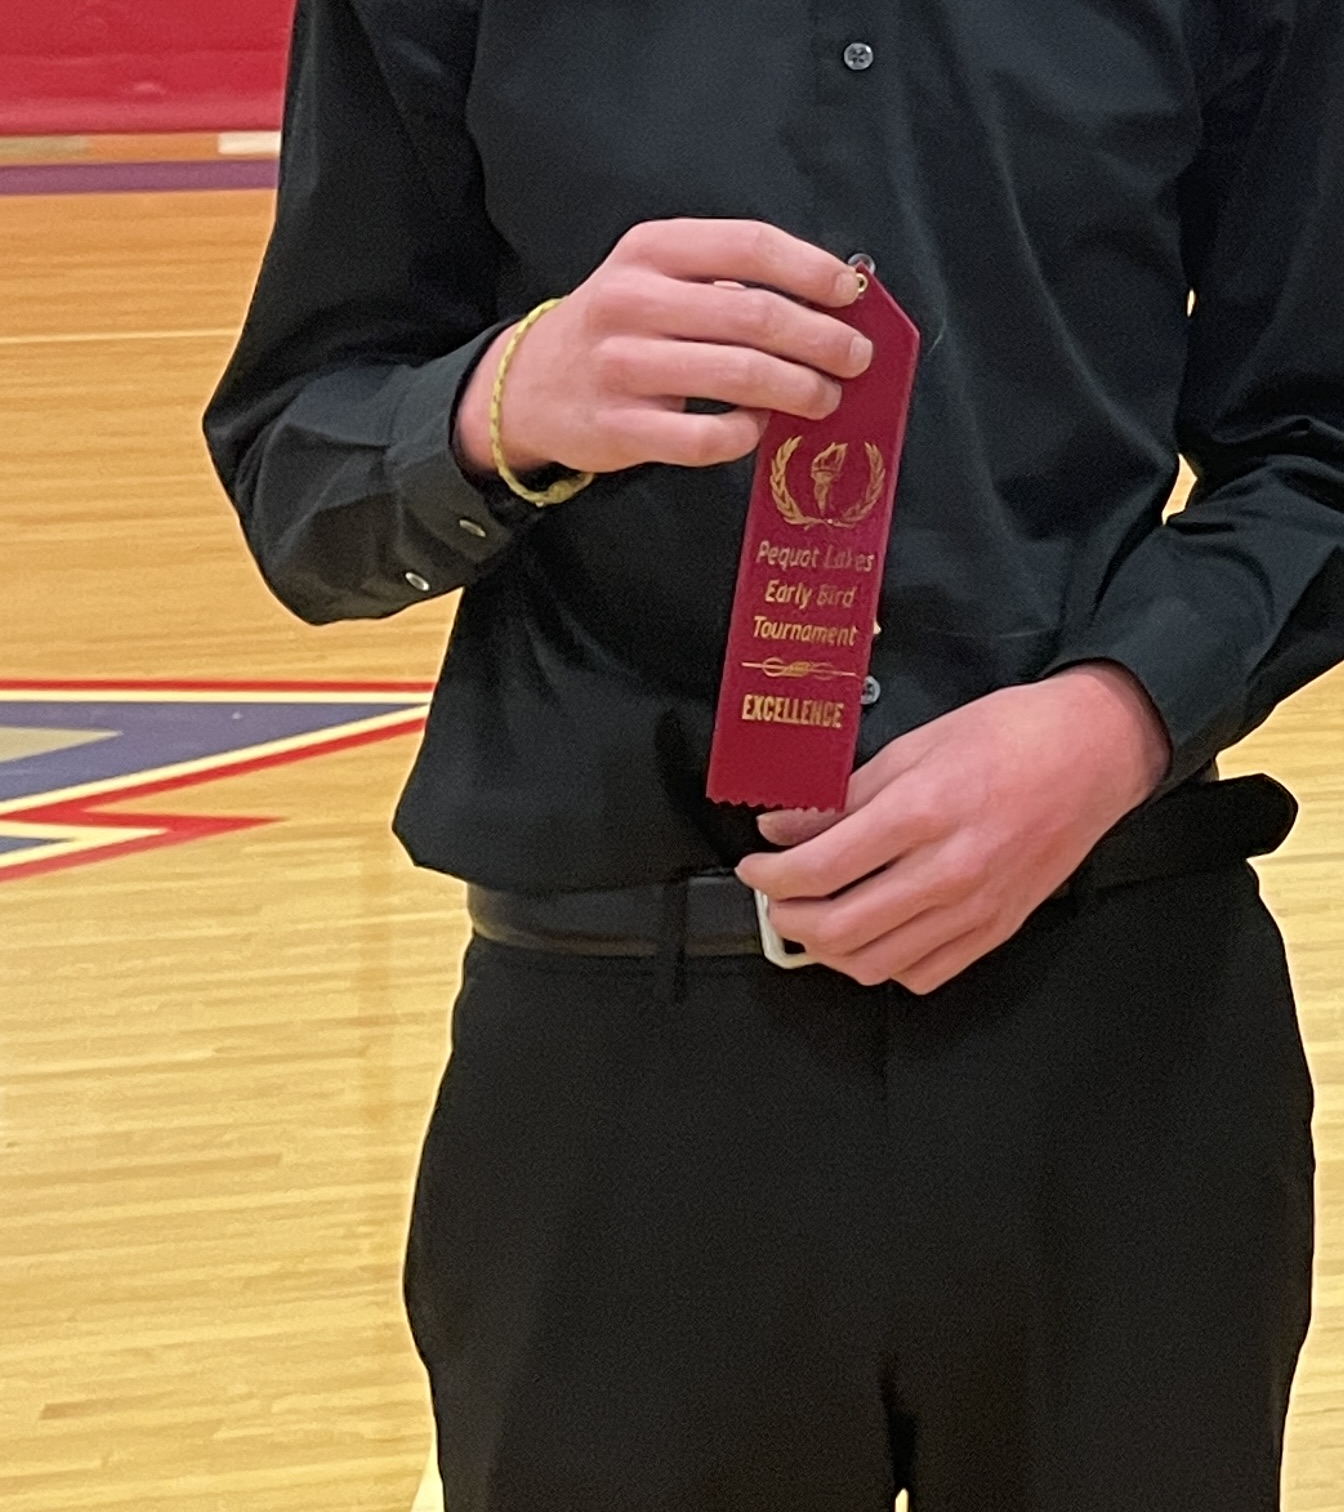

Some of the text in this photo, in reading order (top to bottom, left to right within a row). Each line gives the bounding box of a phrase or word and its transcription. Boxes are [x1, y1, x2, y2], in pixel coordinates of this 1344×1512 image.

[756, 540, 874, 572] Pequot Lakes
[765, 579, 857, 609] Early Bird
[753, 615, 857, 646] Tournament
[742, 694, 844, 728] EXCELLENCE
